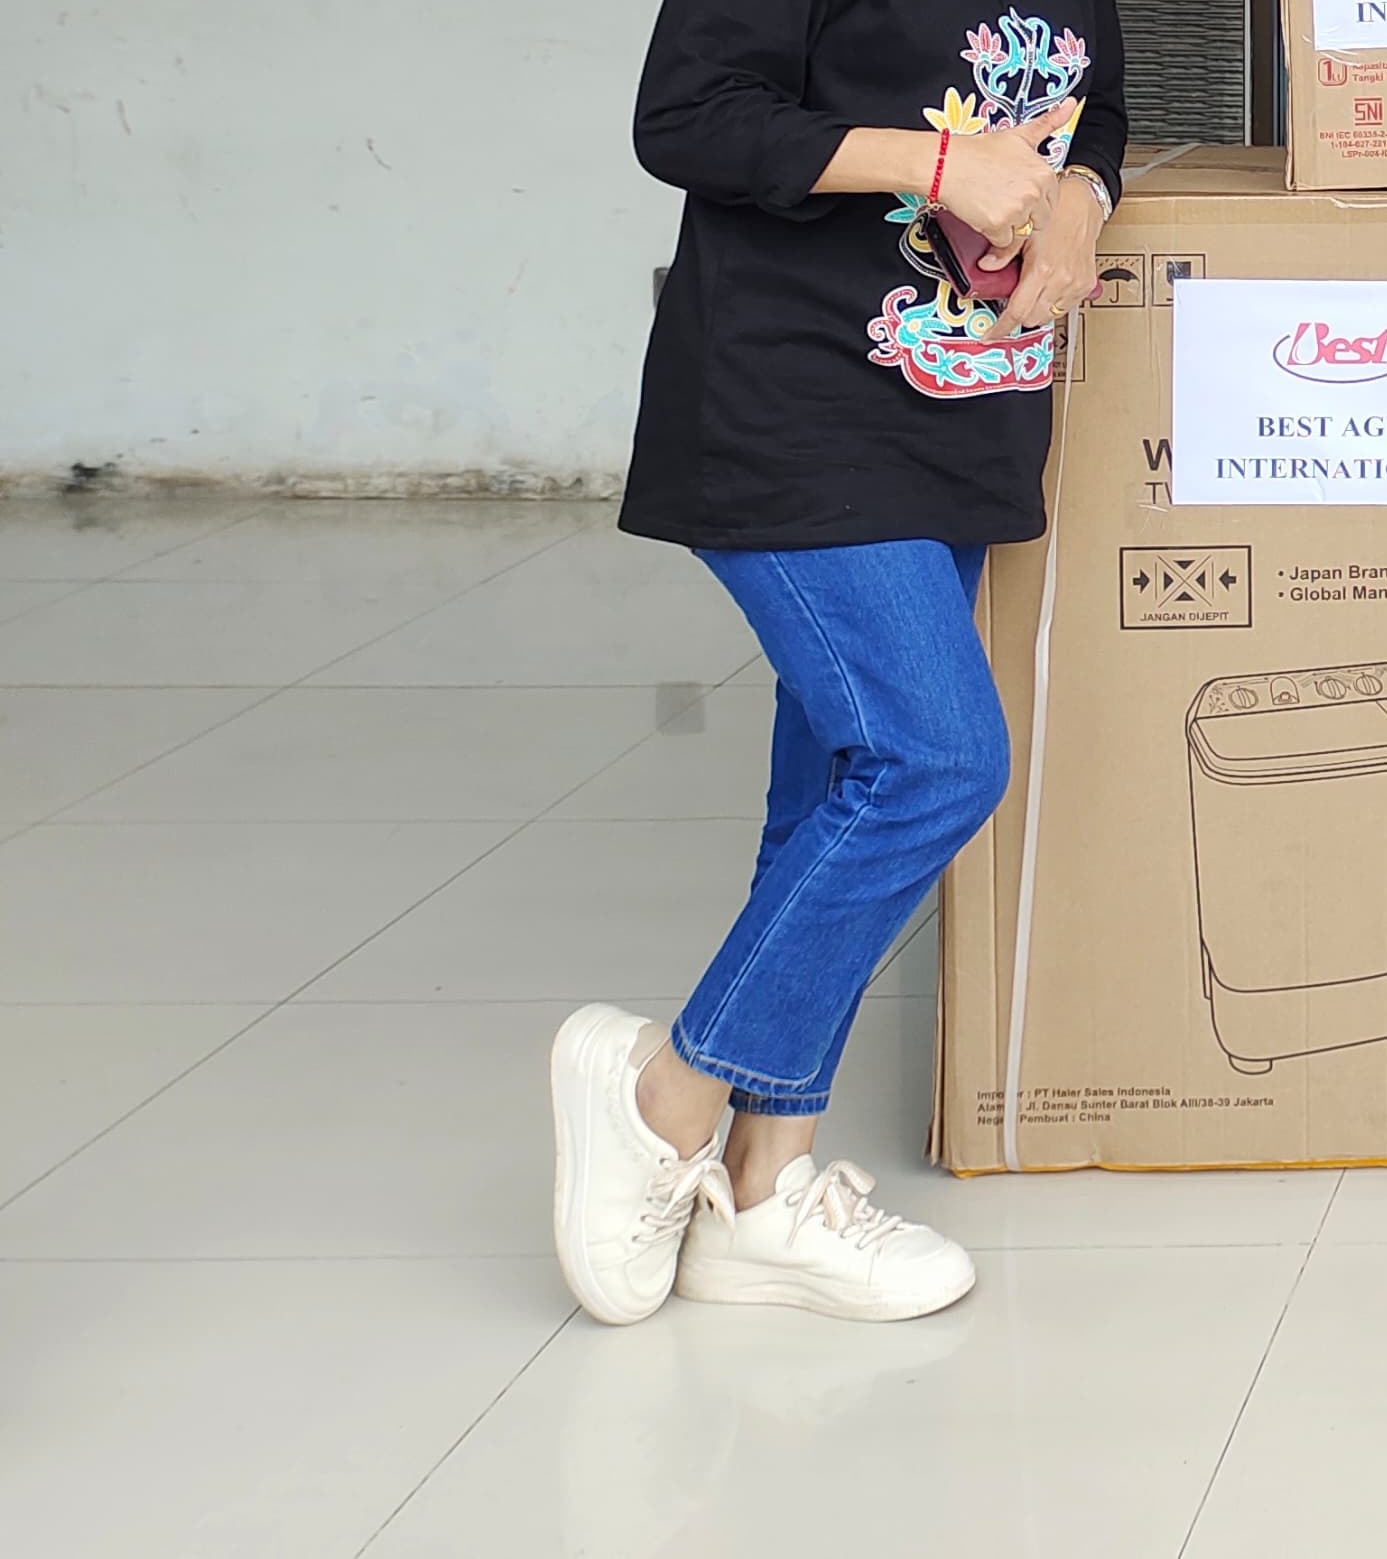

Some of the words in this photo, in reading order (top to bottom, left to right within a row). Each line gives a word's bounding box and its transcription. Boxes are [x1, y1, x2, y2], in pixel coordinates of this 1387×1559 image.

[1354, 98, 1382, 126] SNI
[1257, 416, 1332, 437] BEST
[1290, 567, 1342, 582] Japan
[1290, 587, 1346, 601] Global
[1140, 613, 1186, 622] JANGAN
[1034, 1089, 1049, 1098] PT
[1084, 1087, 1114, 1097] Sales
[1081, 1099, 1116, 1110] Sunter
[1152, 1098, 1177, 1109] Blok
[1234, 1096, 1274, 1107] Jakarta
[1079, 1112, 1111, 1122] China
